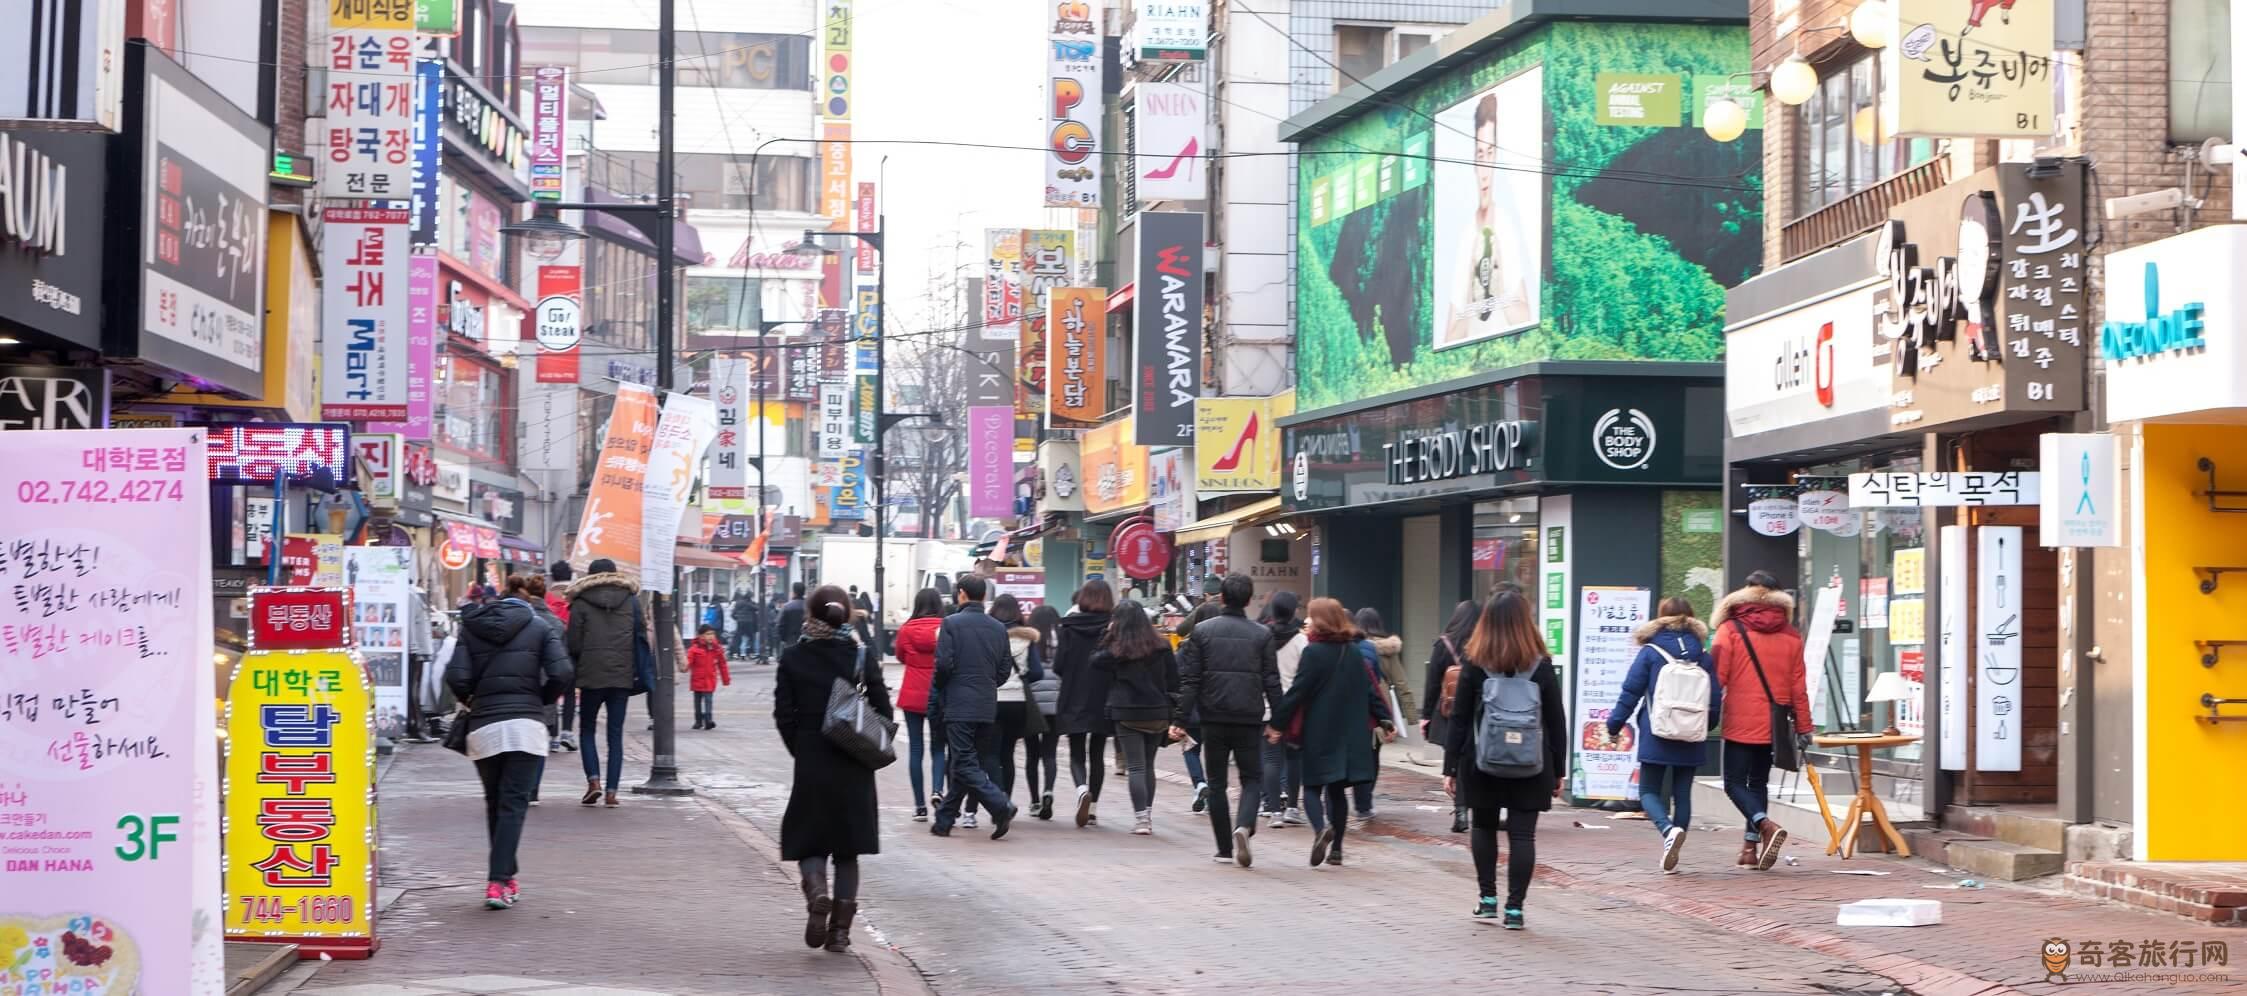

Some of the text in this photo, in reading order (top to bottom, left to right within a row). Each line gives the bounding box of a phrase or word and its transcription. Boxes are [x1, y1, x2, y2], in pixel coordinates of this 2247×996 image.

[1147, 5, 1201, 17] RIAHN
[329, 35, 355, 162] 감자탕
[356, 36, 382, 162] 순대국
[384, 37, 412, 164] 육개장
[1608, 83, 1664, 93] AGAINST
[346, 172, 390, 193] 전문
[2010, 192, 2078, 254] 生
[346, 227, 385, 307] 맥주
[540, 325, 576, 337] Steak
[1155, 245, 1197, 408] WARAWARA
[346, 319, 376, 400] Mart
[826, 394, 845, 450] 피부미용
[861, 377, 878, 441] SUBWAY
[719, 410, 737, 471] 김家네
[1176, 424, 1195, 437] 2F
[1605, 436, 1643, 447] BODY
[1612, 427, 1635, 435] THE
[83, 447, 186, 472] 대학로점
[1382, 421, 1521, 485] THE BODY SHOP
[1607, 447, 1641, 458] SHOP
[18, 480, 184, 503] 02.742.4274
[1862, 471, 2021, 506] 식탁의 목적
[1251, 566, 1299, 577] RIAHN
[14, 584, 181, 617] 특별한 사람에게!
[267, 604, 333, 631] 부동산
[2, 624, 70, 659] 특별한
[253, 669, 343, 697] 대학로
[52, 689, 119, 724] 만들어
[249, 752, 341, 887] 부동산
[115, 815, 180, 861] 3F
[7, 860, 93, 871] DAN HANA
[239, 895, 354, 924] 744-1660
